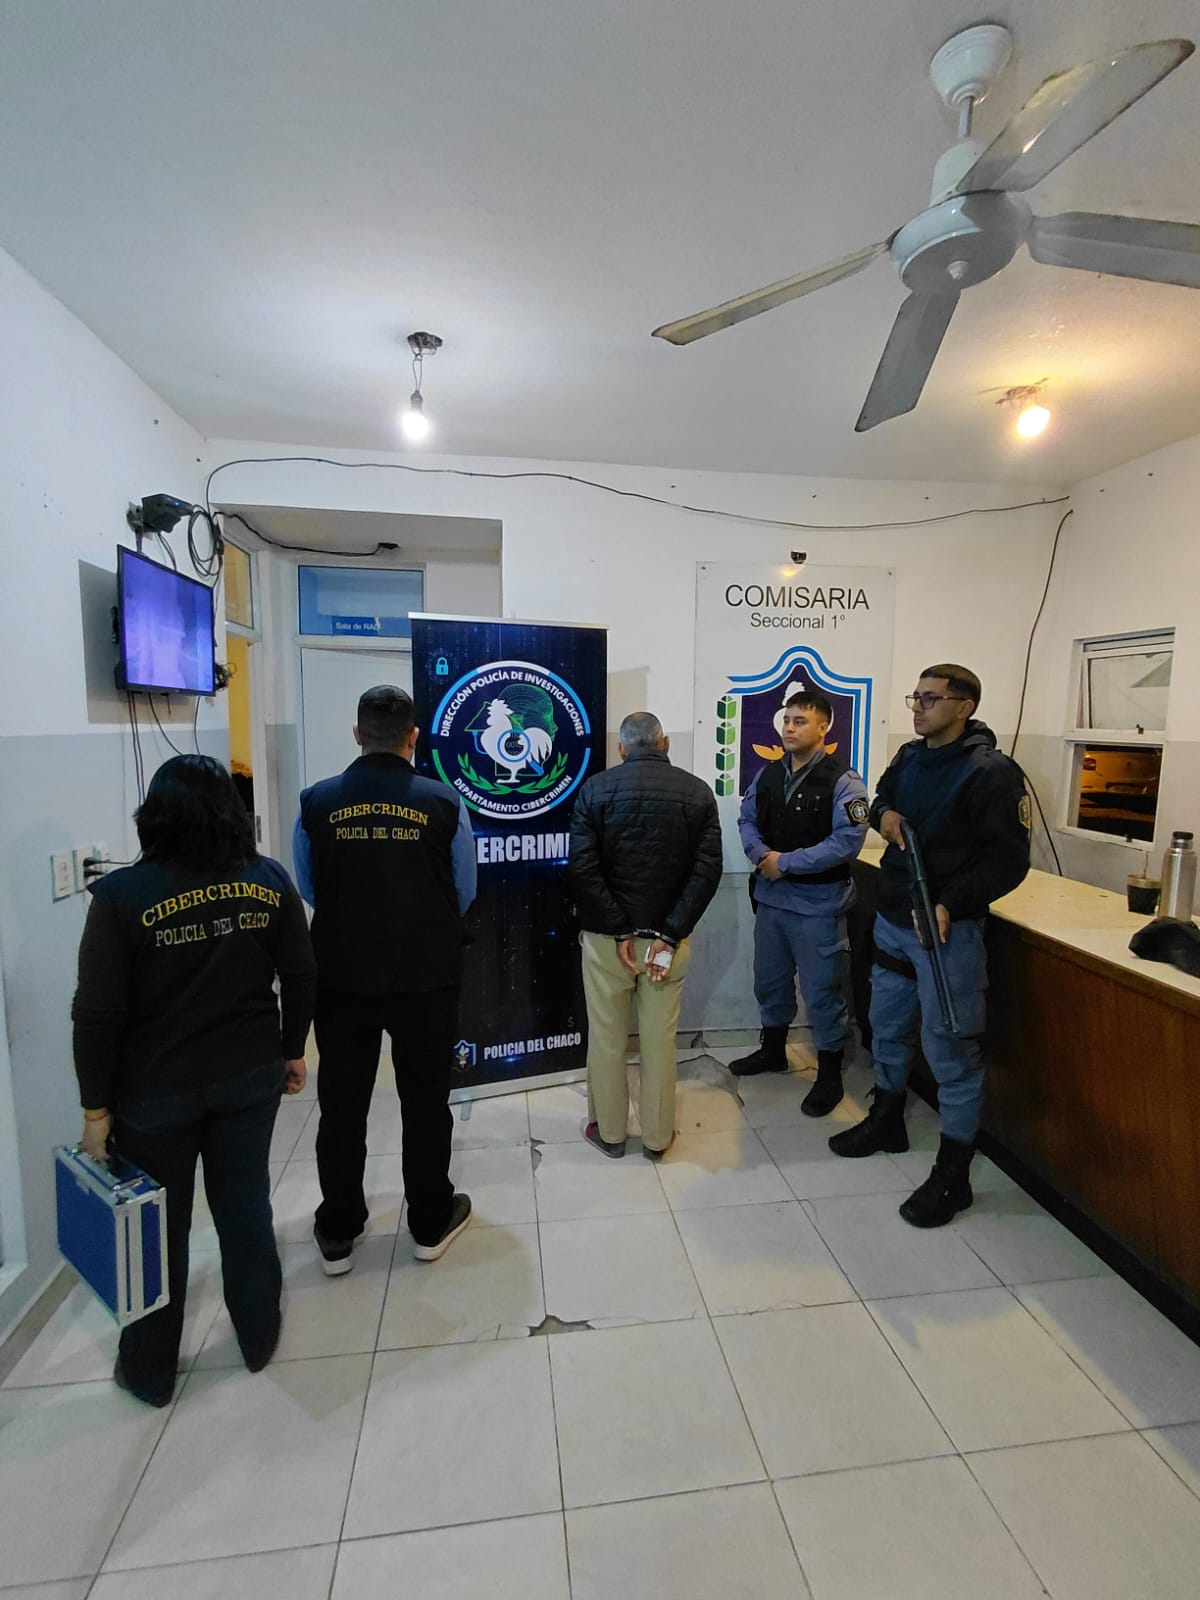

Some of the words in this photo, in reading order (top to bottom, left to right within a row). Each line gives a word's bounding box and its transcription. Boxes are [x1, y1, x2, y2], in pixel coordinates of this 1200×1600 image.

[725, 584, 870, 610] COMISARIA
[353, 623, 362, 631] de
[750, 612, 825, 629] Seccional
[440, 686, 473, 737] DIRECCIÓN
[470, 670, 510, 691] POLICÍA
[511, 671, 523, 680] DE
[524, 673, 585, 737] INVESTIGACIONES
[453, 777, 522, 813] DEPARTAMENTO
[521, 775, 573, 811] CIBERCRIMEN
[329, 803, 428, 826] CIBERCRIMEN
[336, 827, 369, 840] POLICIA
[372, 827, 388, 840] DEL
[391, 827, 420, 841] CHACO
[477, 832, 570, 864] ERCRIM
[142, 882, 282, 927] CIBERCRIMEN
[155, 923, 208, 947] POLICIA
[213, 917, 234, 937] DEL
[238, 912, 270, 929] CHACO
[484, 1039, 526, 1060] POLICIA
[527, 1036, 545, 1054] DEL
[546, 1032, 582, 1051] CHACO
